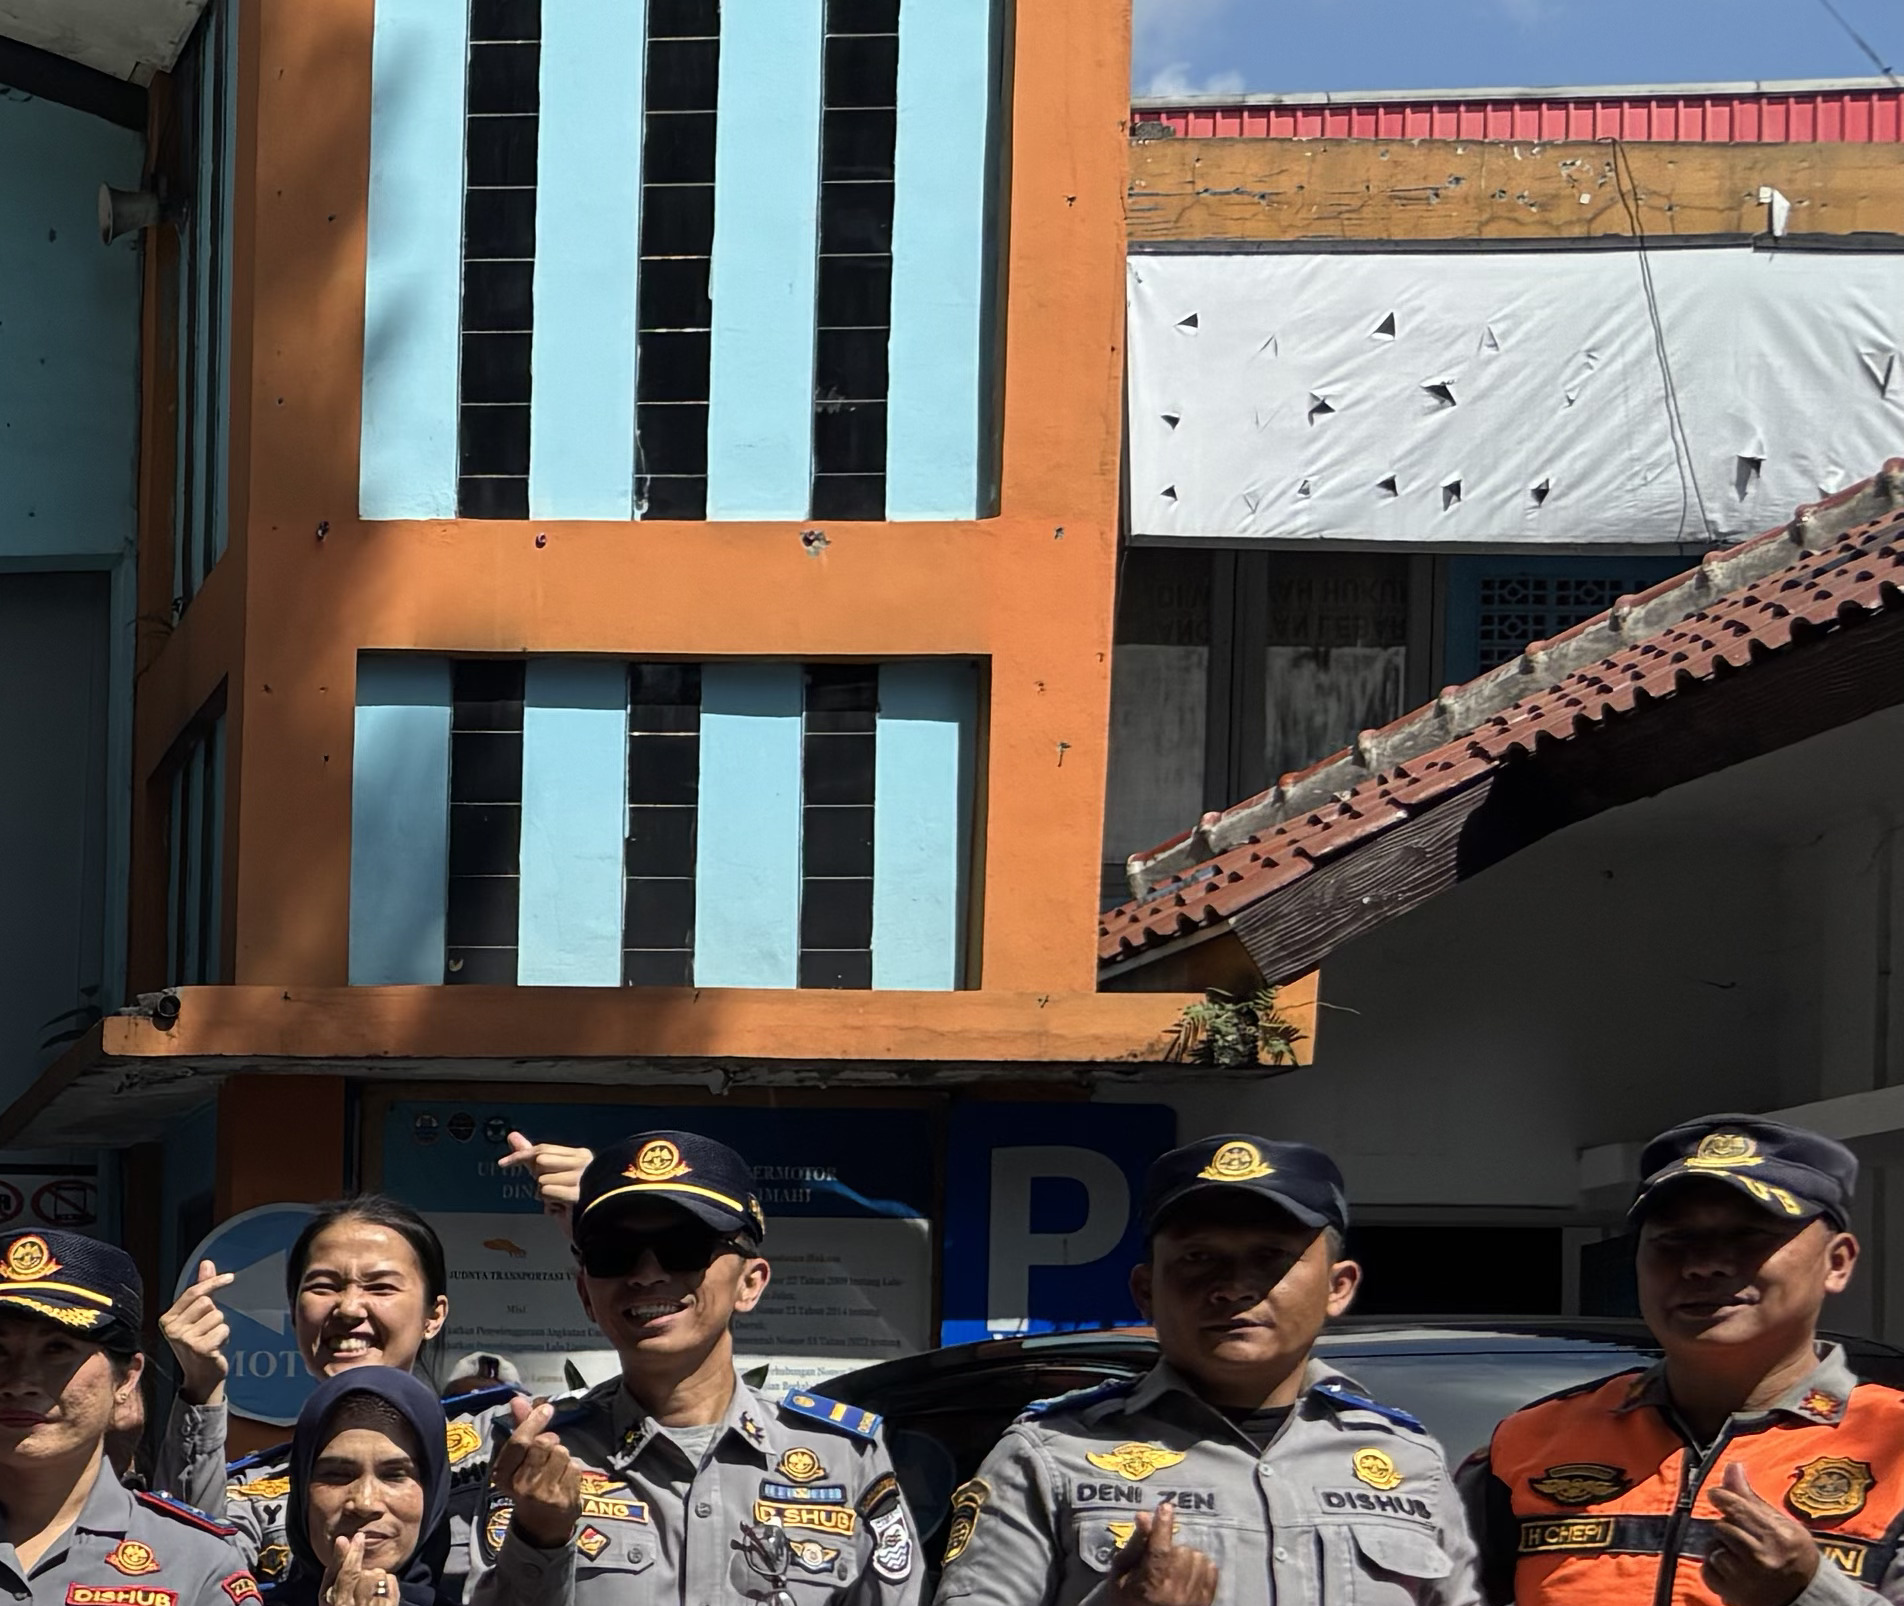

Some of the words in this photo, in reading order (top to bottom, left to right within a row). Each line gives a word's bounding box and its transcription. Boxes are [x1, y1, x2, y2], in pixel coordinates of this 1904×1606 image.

[751, 1165, 838, 1182] ERMOTOR
[757, 1187, 812, 1203] IMAHI
[986, 1145, 1130, 1332] P
[448, 1270, 490, 1281] JUDNYA
[1076, 1482, 1144, 1505] DENI
[1155, 1488, 1216, 1512] ZEN
[1323, 1490, 1432, 1522] DISHUB
[583, 1500, 630, 1519] ANG
[759, 1505, 851, 1529] DSHUB
[1543, 1523, 1605, 1543] CHEPI
